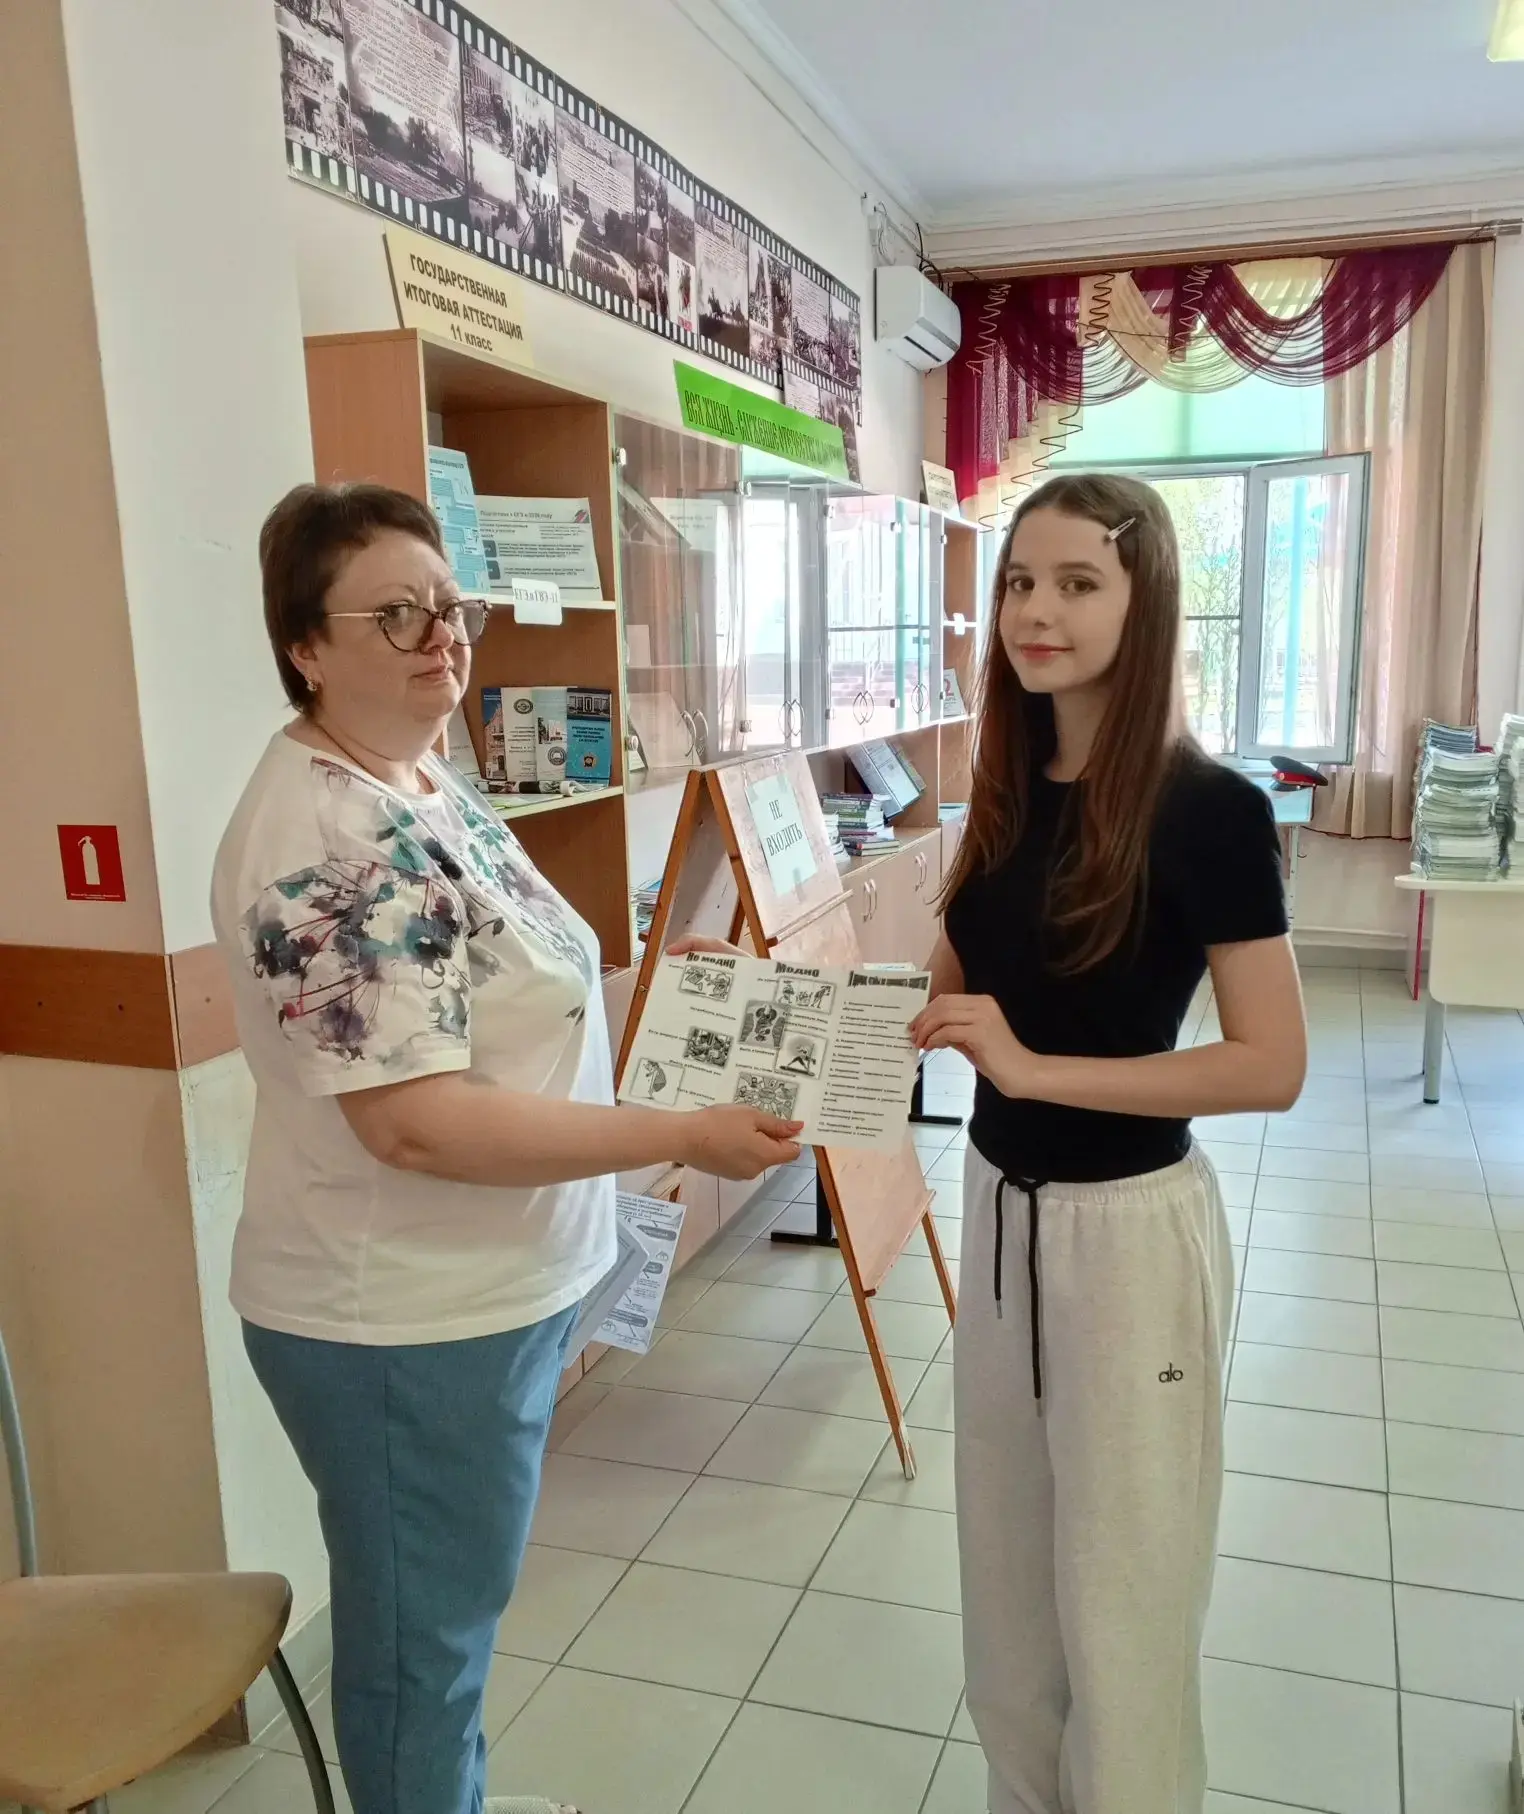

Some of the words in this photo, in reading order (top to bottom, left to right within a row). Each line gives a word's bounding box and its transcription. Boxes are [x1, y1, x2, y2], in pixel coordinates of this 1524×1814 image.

[410, 253, 507, 308] ГОСУДАРСТВЕННАЯ
[403, 281, 460, 318] ИТОГОВАЯ
[463, 304, 523, 340] АТТЕСТАЦИЯ
[451, 323, 463, 342] 11
[465, 332, 493, 351] класс
[769, 799, 782, 821] НЕ
[766, 823, 803, 857] ВХОДИТЬ
[775, 961, 820, 978] Модно
[1159, 1361, 1184, 1383] alo
